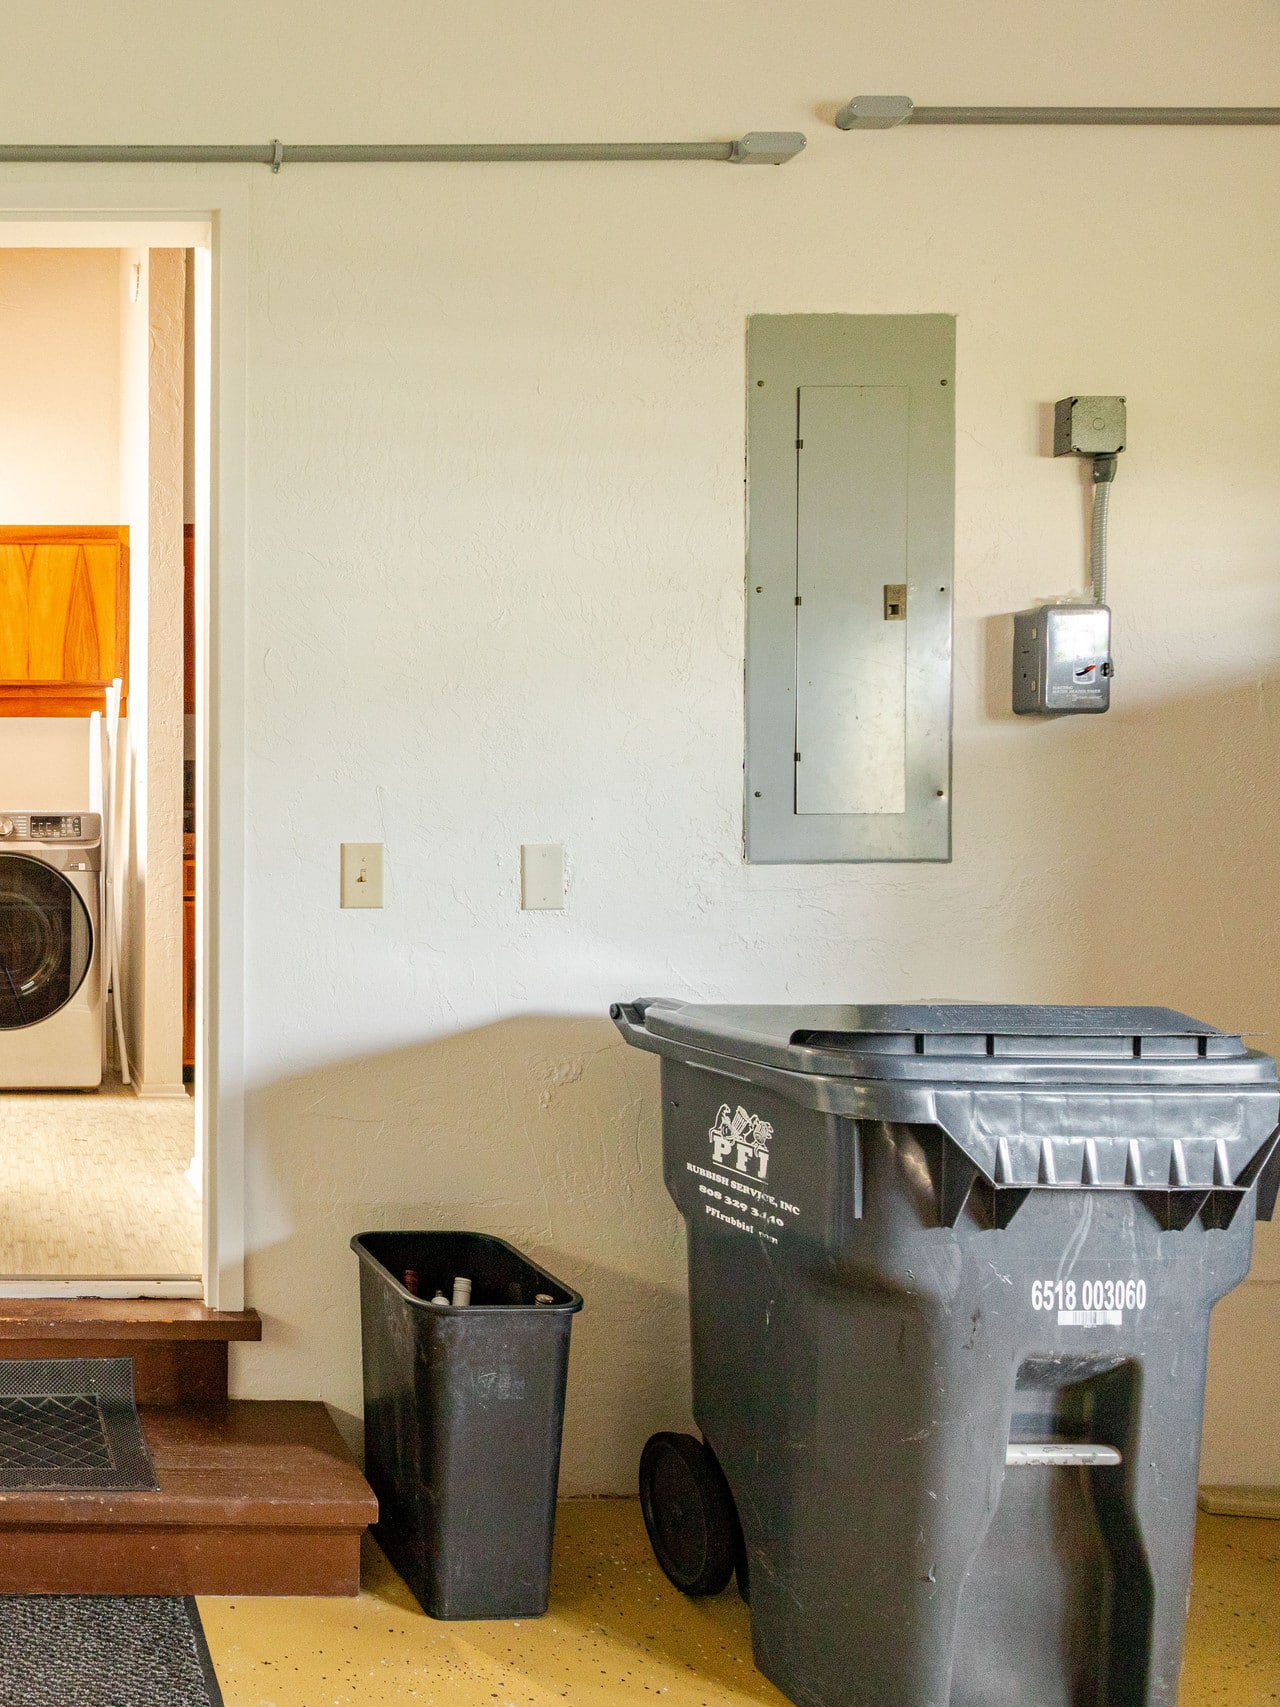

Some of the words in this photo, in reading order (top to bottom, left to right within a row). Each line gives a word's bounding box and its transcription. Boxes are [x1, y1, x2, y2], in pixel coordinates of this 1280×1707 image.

[712, 1135, 769, 1179] PFI
[686, 1162, 729, 1186] RUBBISH
[730, 1180, 778, 1208] SERVICE,
[780, 1200, 800, 1215] INC
[699, 1184, 723, 1200] 808
[724, 1195, 748, 1212] 329
[1031, 1279, 1077, 1311] 6518
[1082, 1279, 1147, 1310] 003060
